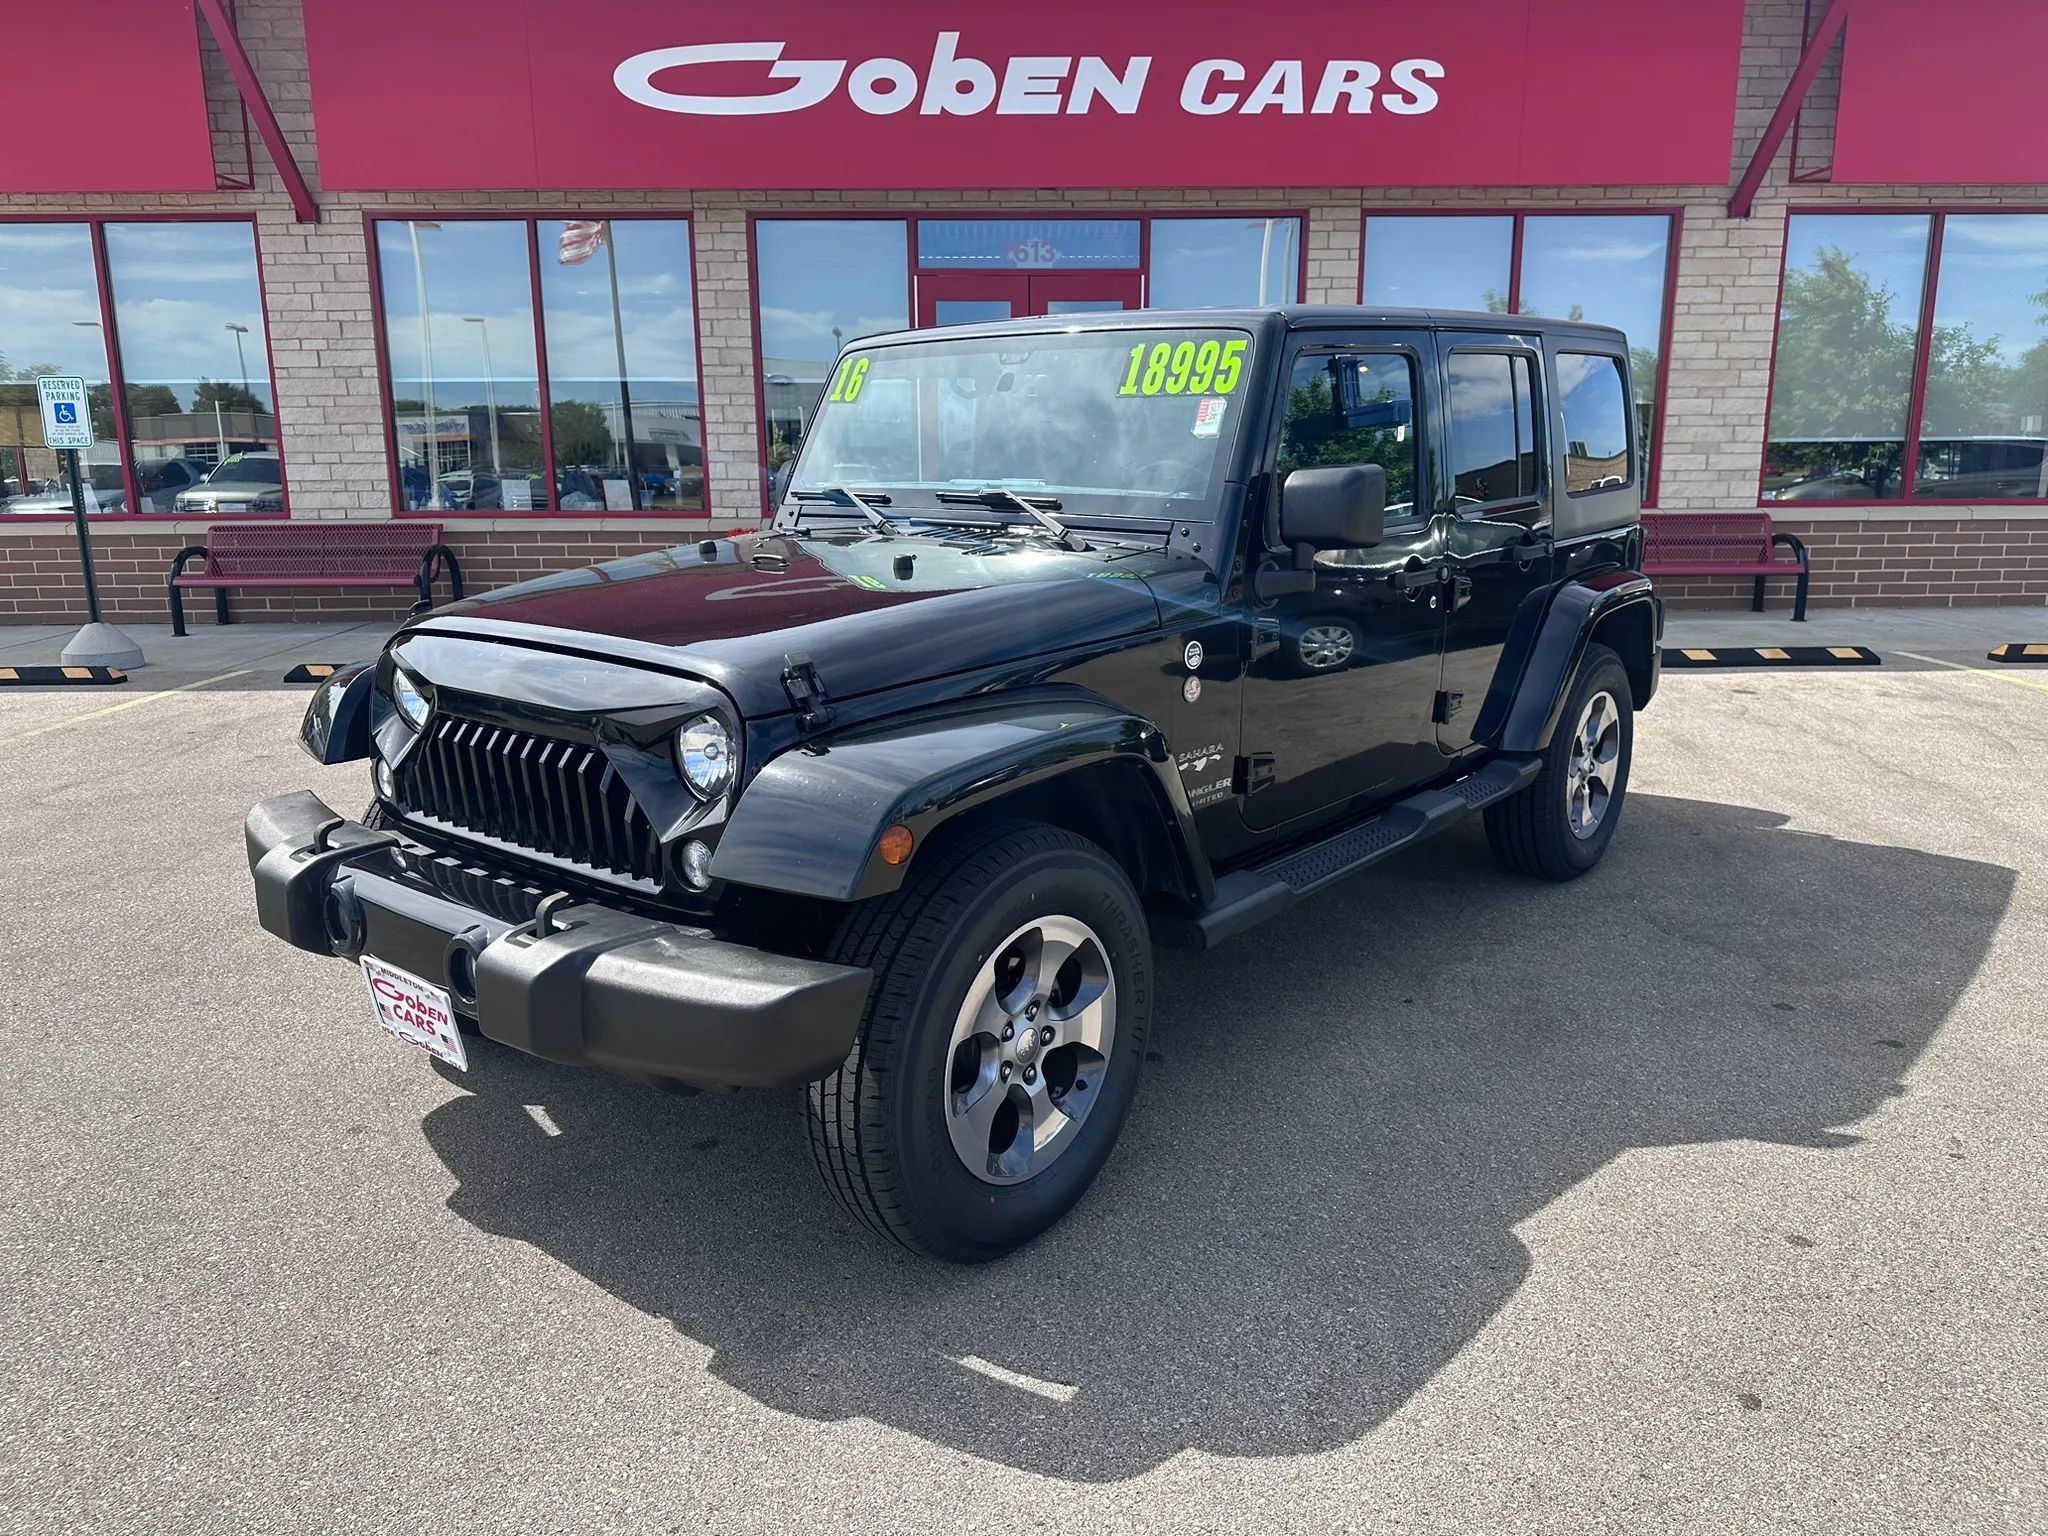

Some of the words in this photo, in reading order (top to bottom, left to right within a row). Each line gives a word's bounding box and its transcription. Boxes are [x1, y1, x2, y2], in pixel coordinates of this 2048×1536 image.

[1179, 58, 1445, 115] CARS
[829, 357, 871, 401] 16
[1118, 339, 1248, 395] 18995
[42, 380, 80, 390] RESERVED
[45, 391, 80, 401] PARKING
[49, 436, 64, 445] THIS
[68, 436, 89, 445] SPACE
[1178, 743, 1225, 763] SAHARA
[1102, 892, 1146, 1004] THRASHER
[381, 967, 424, 992] MIDDLETON
[393, 1003, 436, 1036] CARS
